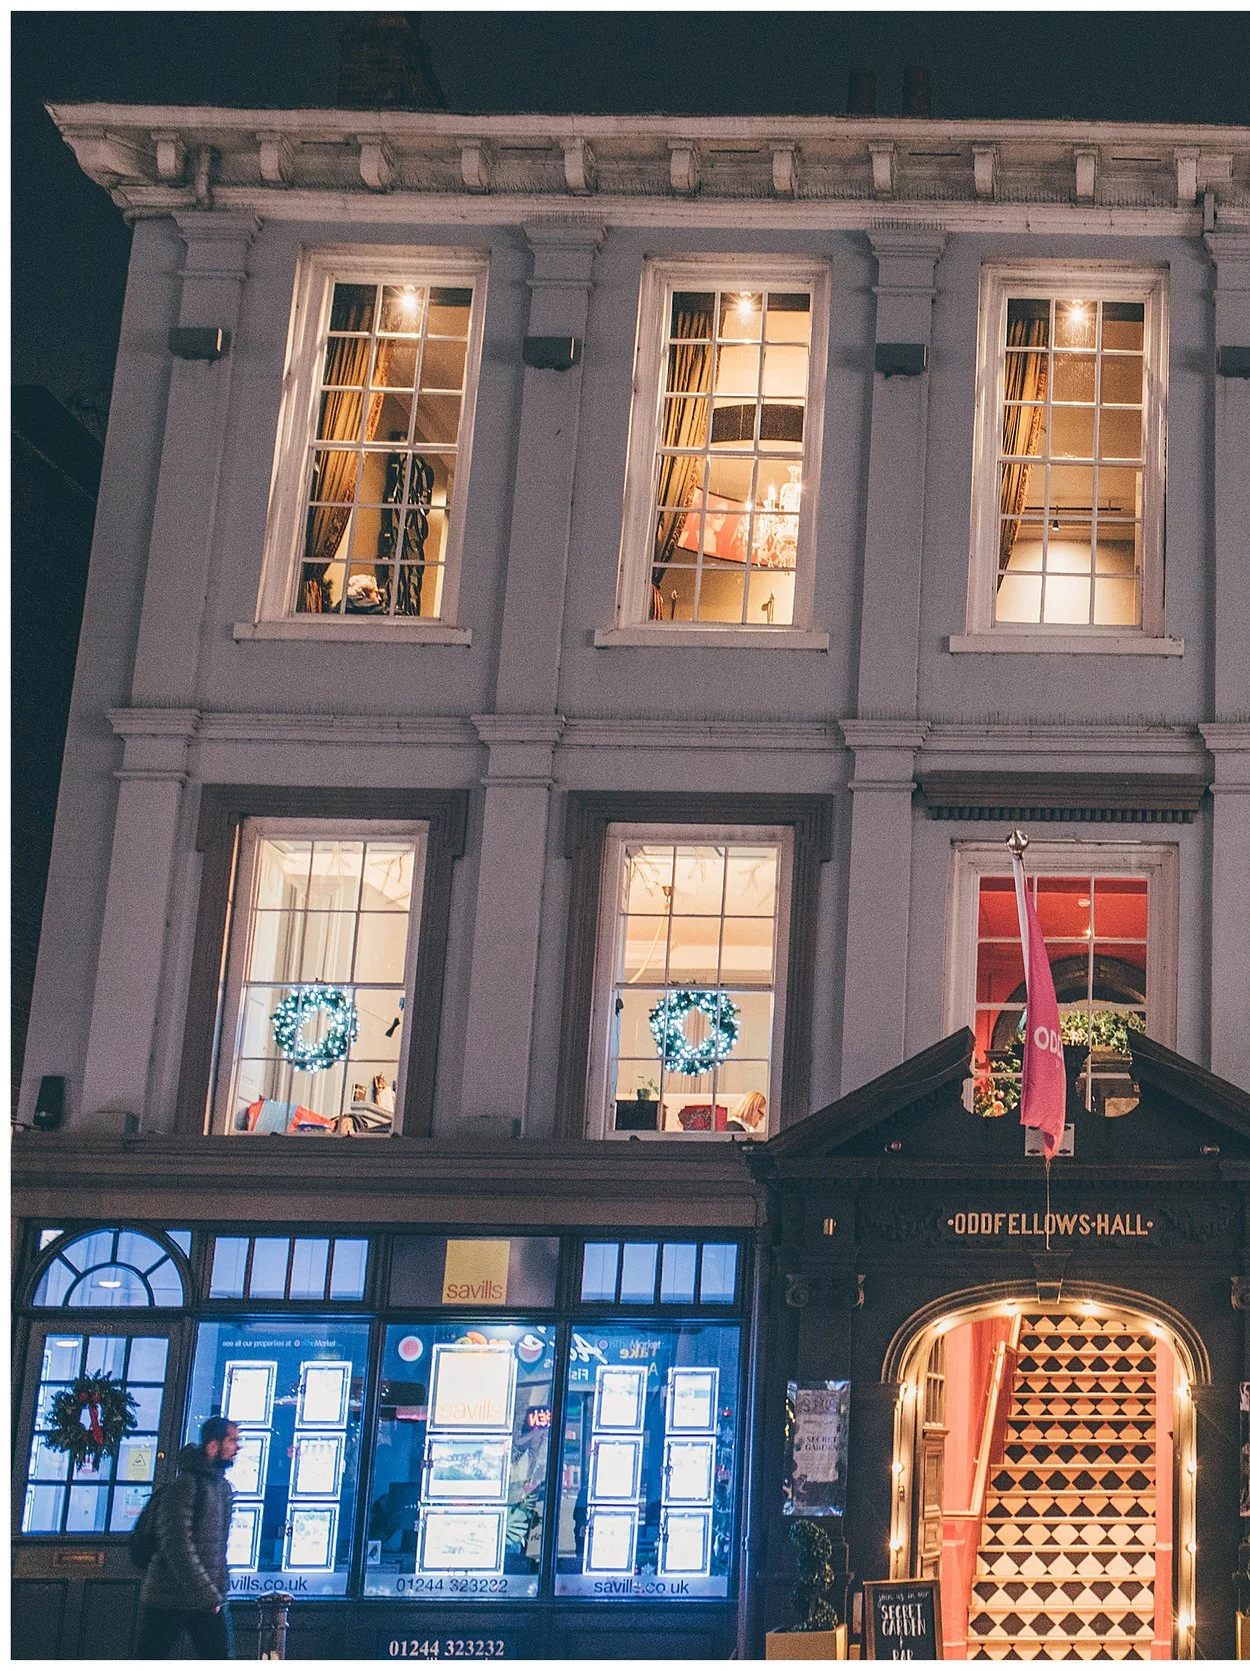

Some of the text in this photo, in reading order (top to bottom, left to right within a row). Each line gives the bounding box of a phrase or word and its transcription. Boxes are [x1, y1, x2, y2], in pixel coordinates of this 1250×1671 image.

[954, 1213, 1149, 1236] ODDFELLOWS HALL
[446, 1280, 502, 1299] savills
[253, 1339, 285, 1348] properties
[440, 1400, 501, 1419] savills
[229, 1576, 308, 1591] vills.co.uk
[396, 1578, 508, 1592] 01244 323232
[594, 1579, 690, 1594] savills.couk
[881, 1603, 923, 1620] SECRET
[882, 1618, 926, 1637] GARDEN
[389, 1640, 504, 1656] 01244 323232
